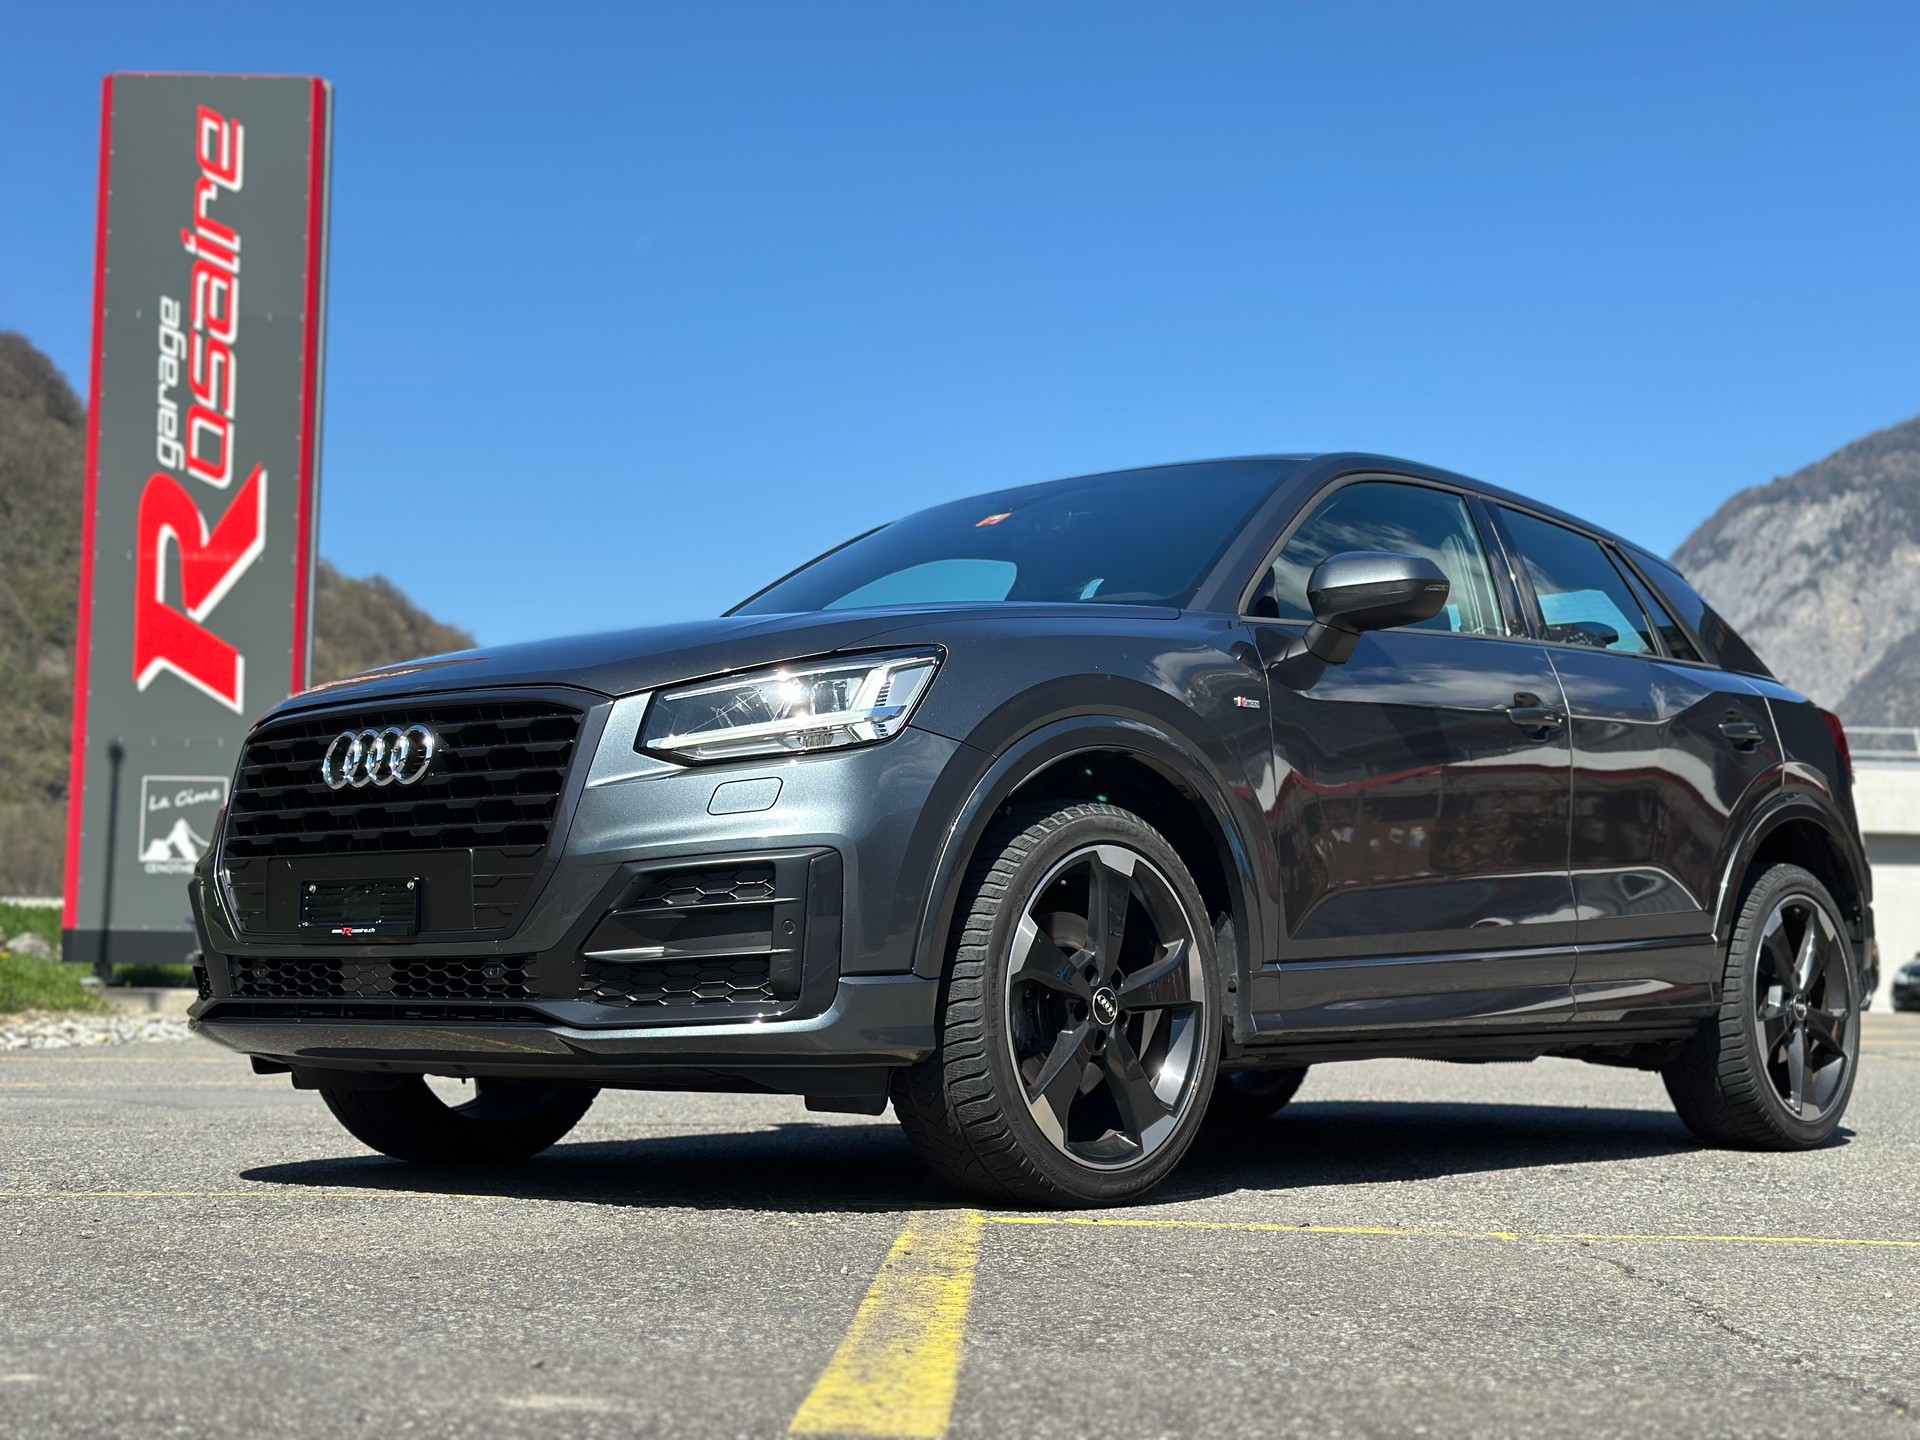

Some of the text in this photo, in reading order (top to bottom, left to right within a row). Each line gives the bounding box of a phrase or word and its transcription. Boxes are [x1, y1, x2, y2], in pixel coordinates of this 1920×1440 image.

[133, 104, 268, 714] Rosaire
[154, 295, 187, 471] garage
[148, 788, 221, 812] La Cime
